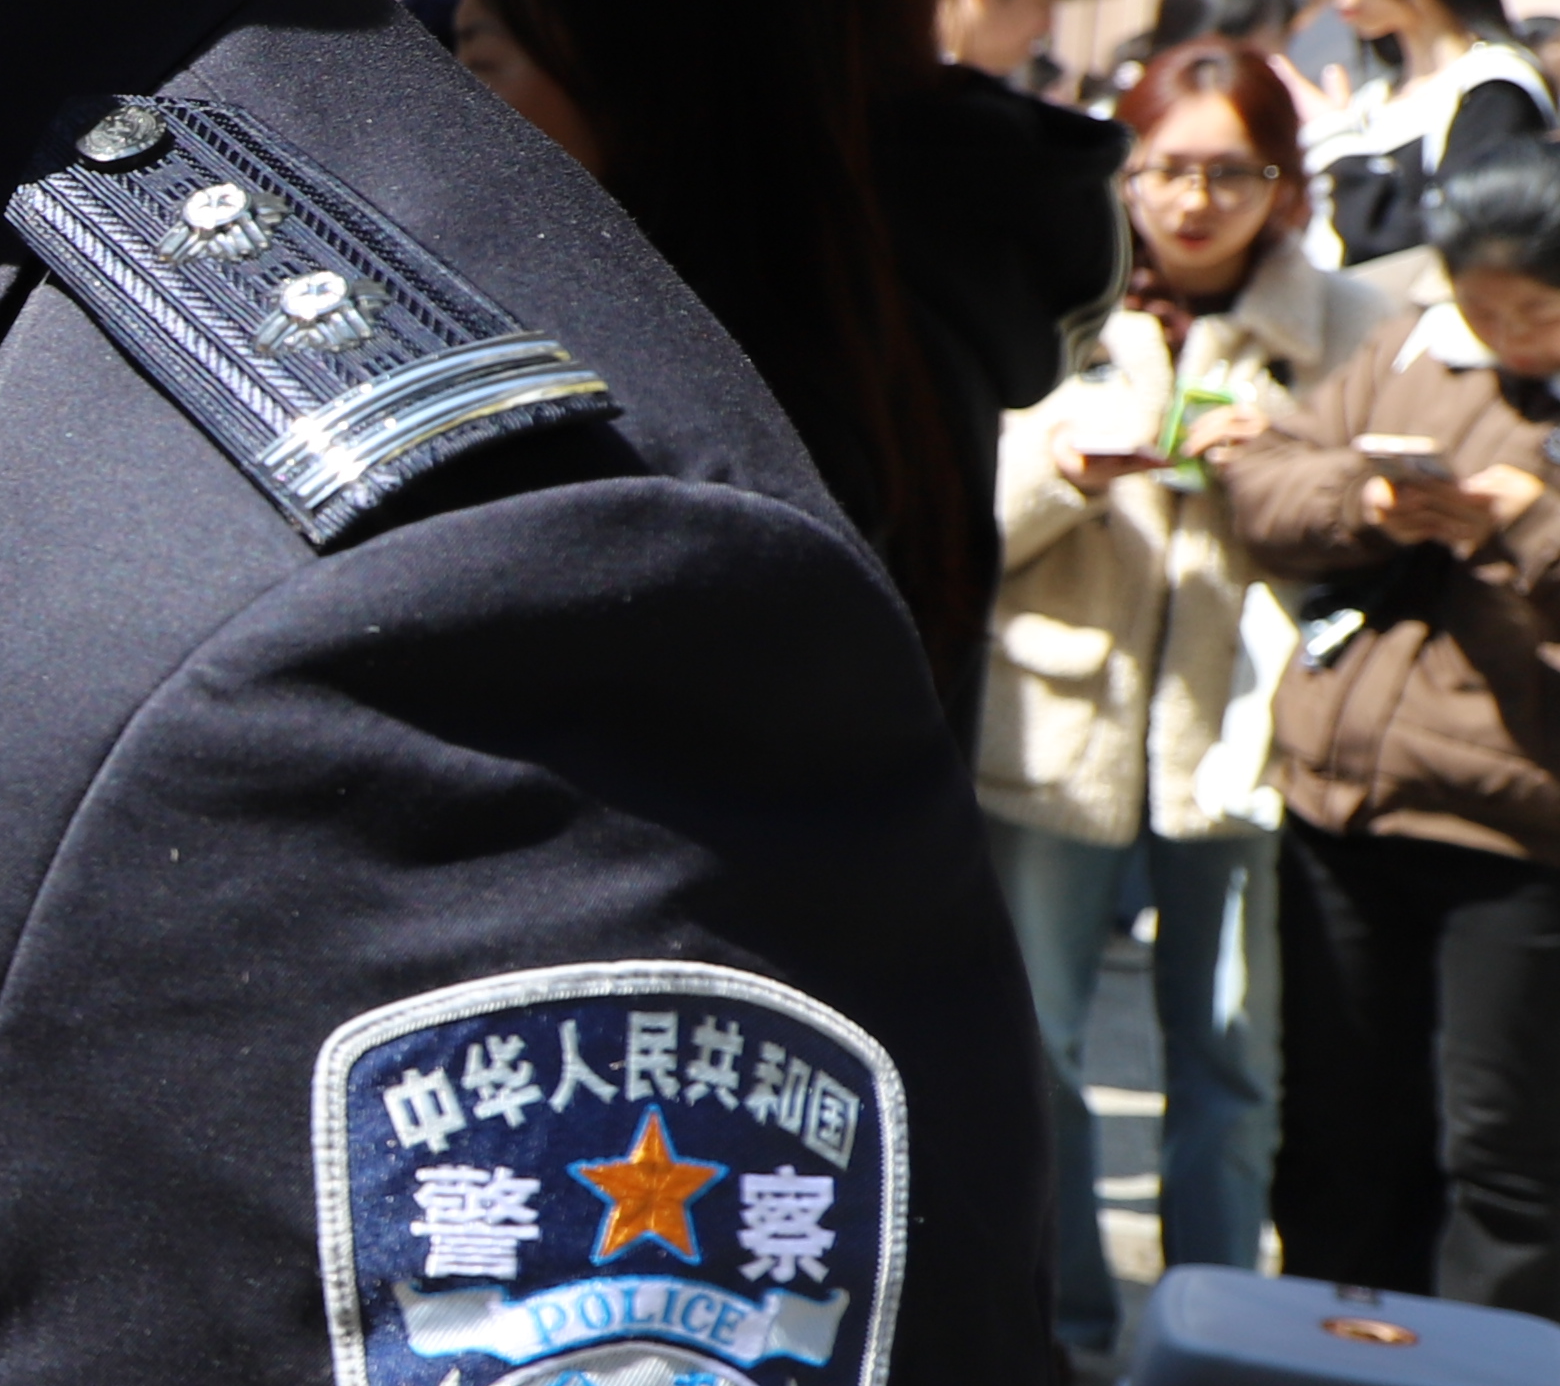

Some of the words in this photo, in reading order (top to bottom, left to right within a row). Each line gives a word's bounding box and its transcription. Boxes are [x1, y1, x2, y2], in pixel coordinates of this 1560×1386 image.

[381, 1010, 862, 1172] 中华人民共和国
[410, 1164, 837, 1283] 警察
[526, 1291, 748, 1349] POLICE
